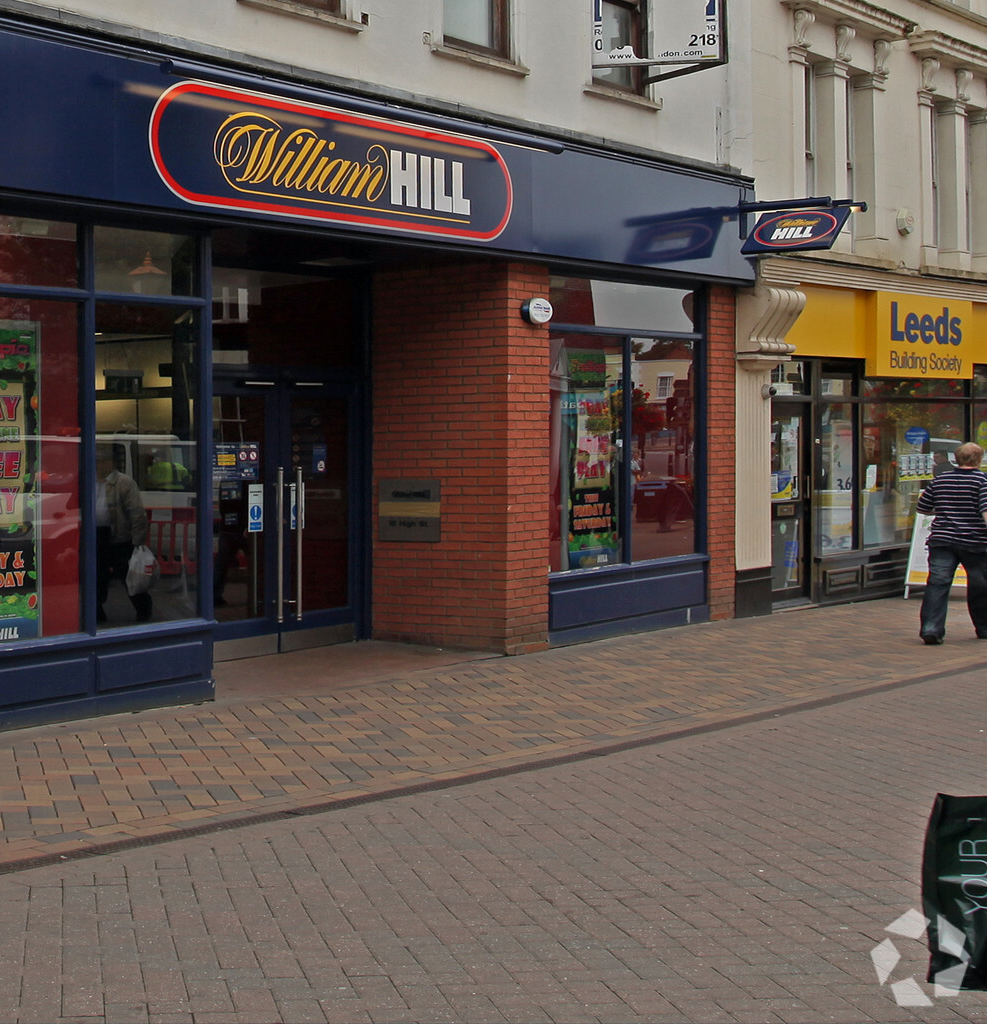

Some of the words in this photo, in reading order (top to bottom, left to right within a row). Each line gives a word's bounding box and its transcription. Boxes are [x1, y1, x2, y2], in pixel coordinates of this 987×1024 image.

[688, 34, 717, 47] 218
[214, 111, 391, 202] William
[390, 149, 471, 216] HILL
[770, 226, 813, 240] HILL
[890, 301, 963, 346] Leeds
[890, 350, 928, 374] Building
[929, 352, 963, 375] Society
[12, 550, 26, 569] &
